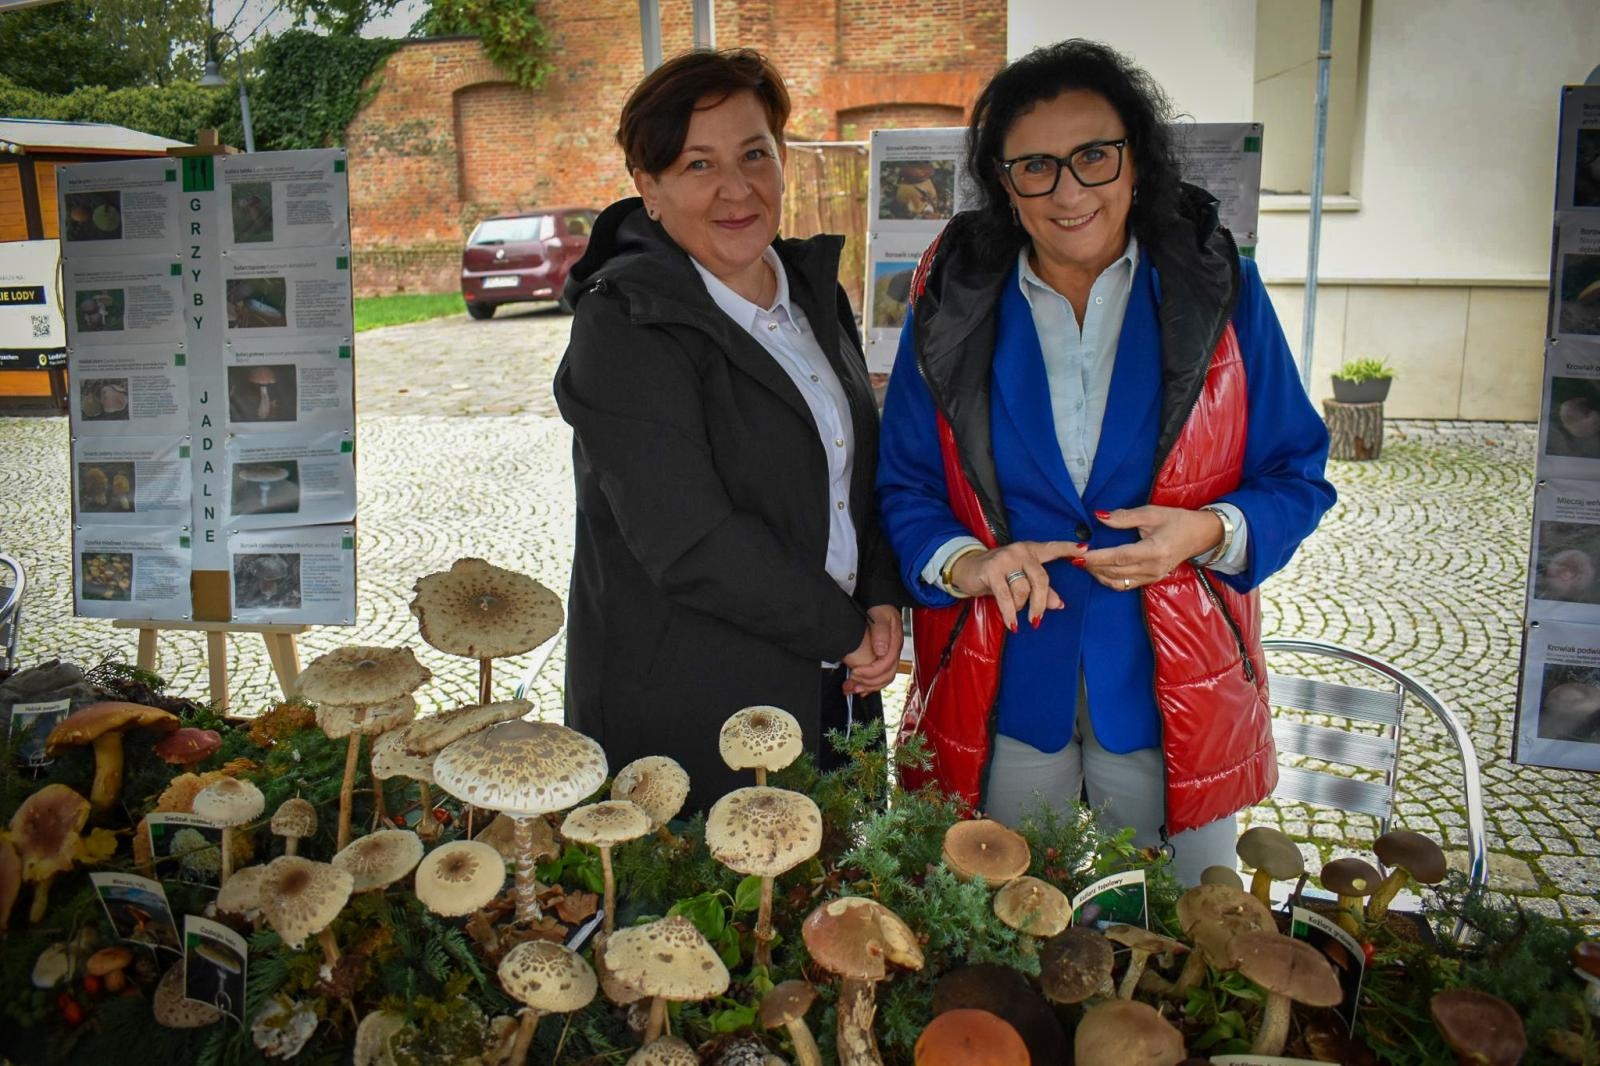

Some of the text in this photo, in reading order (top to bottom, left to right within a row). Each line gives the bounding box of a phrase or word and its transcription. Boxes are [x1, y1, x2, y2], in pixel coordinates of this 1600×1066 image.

[0, 290, 36, 302] IE LODY
[189, 198, 204, 331] GRZYBY
[199, 391, 215, 543] JADALNE
[1547, 643, 1576, 653] Krowiak
